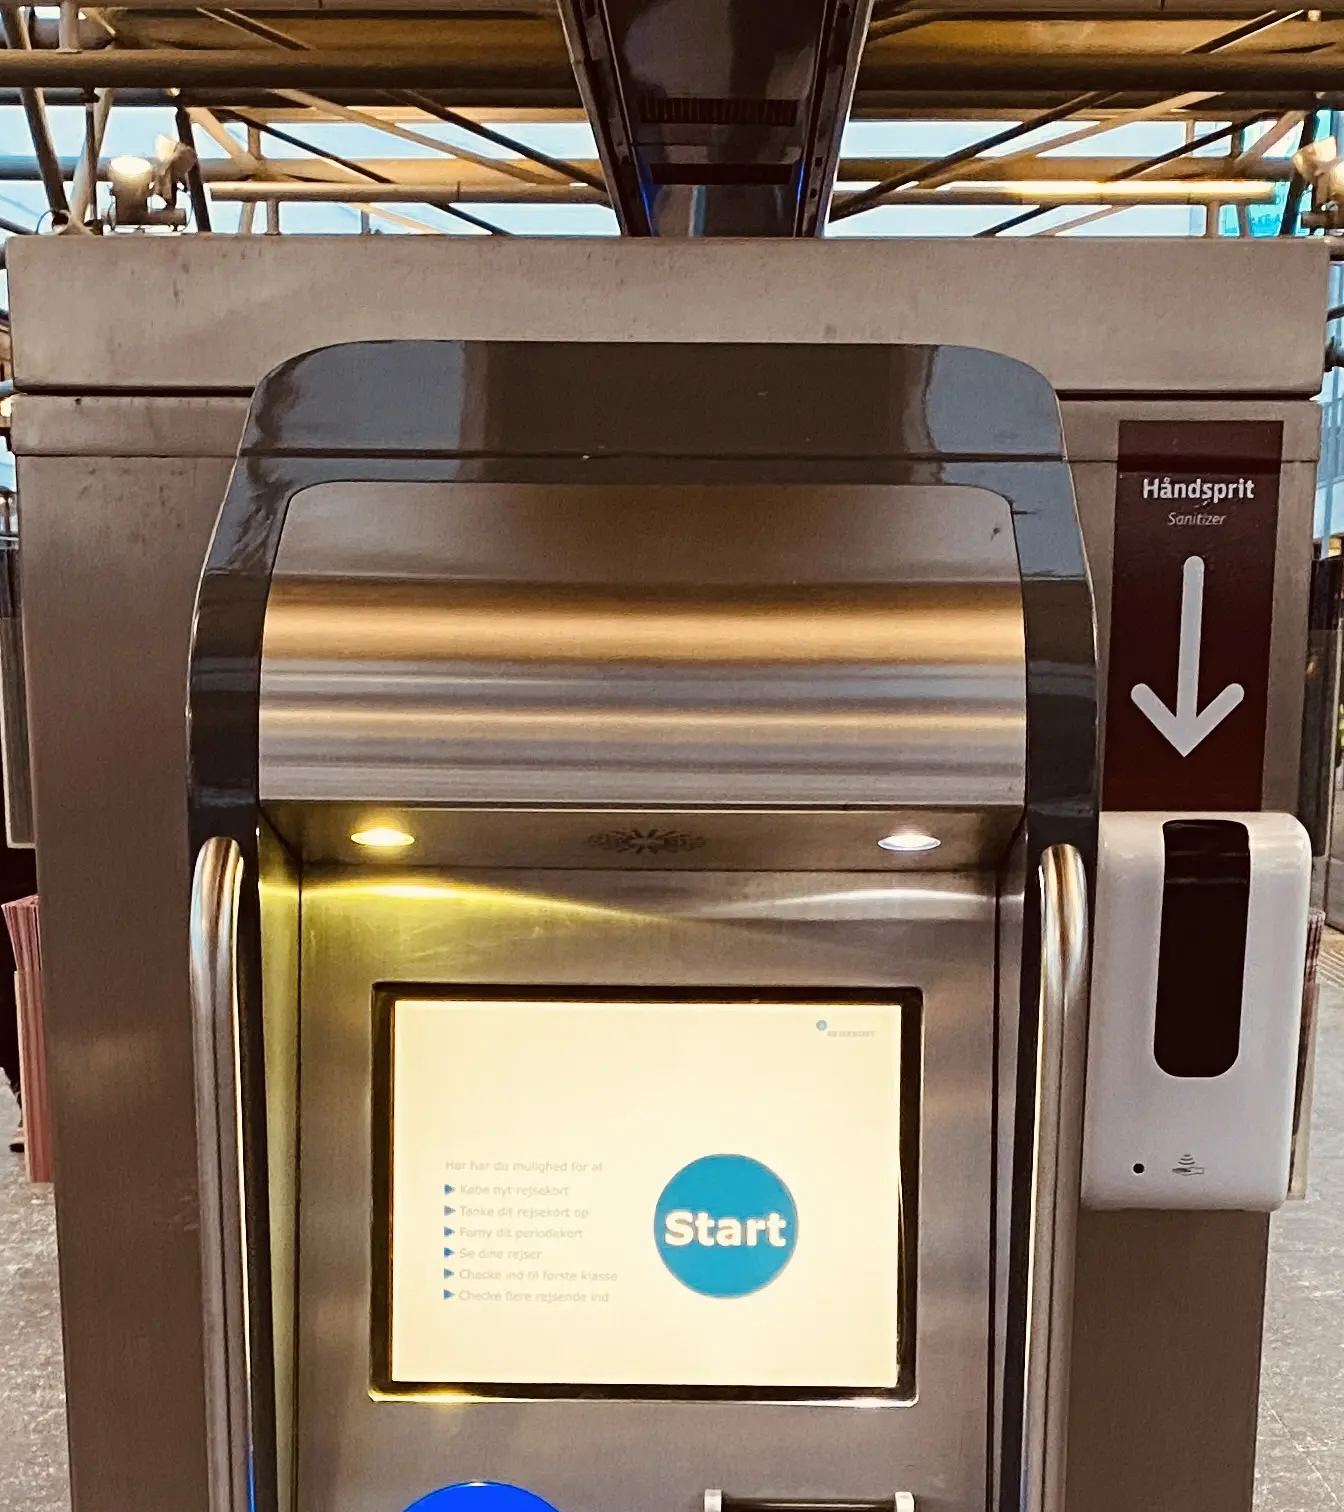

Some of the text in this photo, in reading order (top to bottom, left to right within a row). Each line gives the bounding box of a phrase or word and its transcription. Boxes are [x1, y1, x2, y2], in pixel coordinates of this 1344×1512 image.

[1143, 477, 1255, 504] Håndsprit
[1167, 511, 1227, 527] Sanitizer
[470, 1160, 491, 1171] har
[493, 1160, 509, 1171] du
[512, 1161, 567, 1174] mulighed
[571, 1162, 588, 1172] for
[493, 1186, 512, 1198] nyt
[516, 1185, 570, 1198] rejsekort
[459, 1206, 589, 1219] Tanke dit rejsekort op
[459, 1227, 584, 1240] Forny dit periodekort
[663, 1210, 787, 1247] Start
[459, 1248, 543, 1262] Se dine rejser
[459, 1269, 502, 1280] Checke
[505, 1270, 524, 1280] ind
[527, 1270, 539, 1281] til
[581, 1271, 619, 1282] klasse
[458, 1290, 610, 1304] Checke flere rejsende ind
